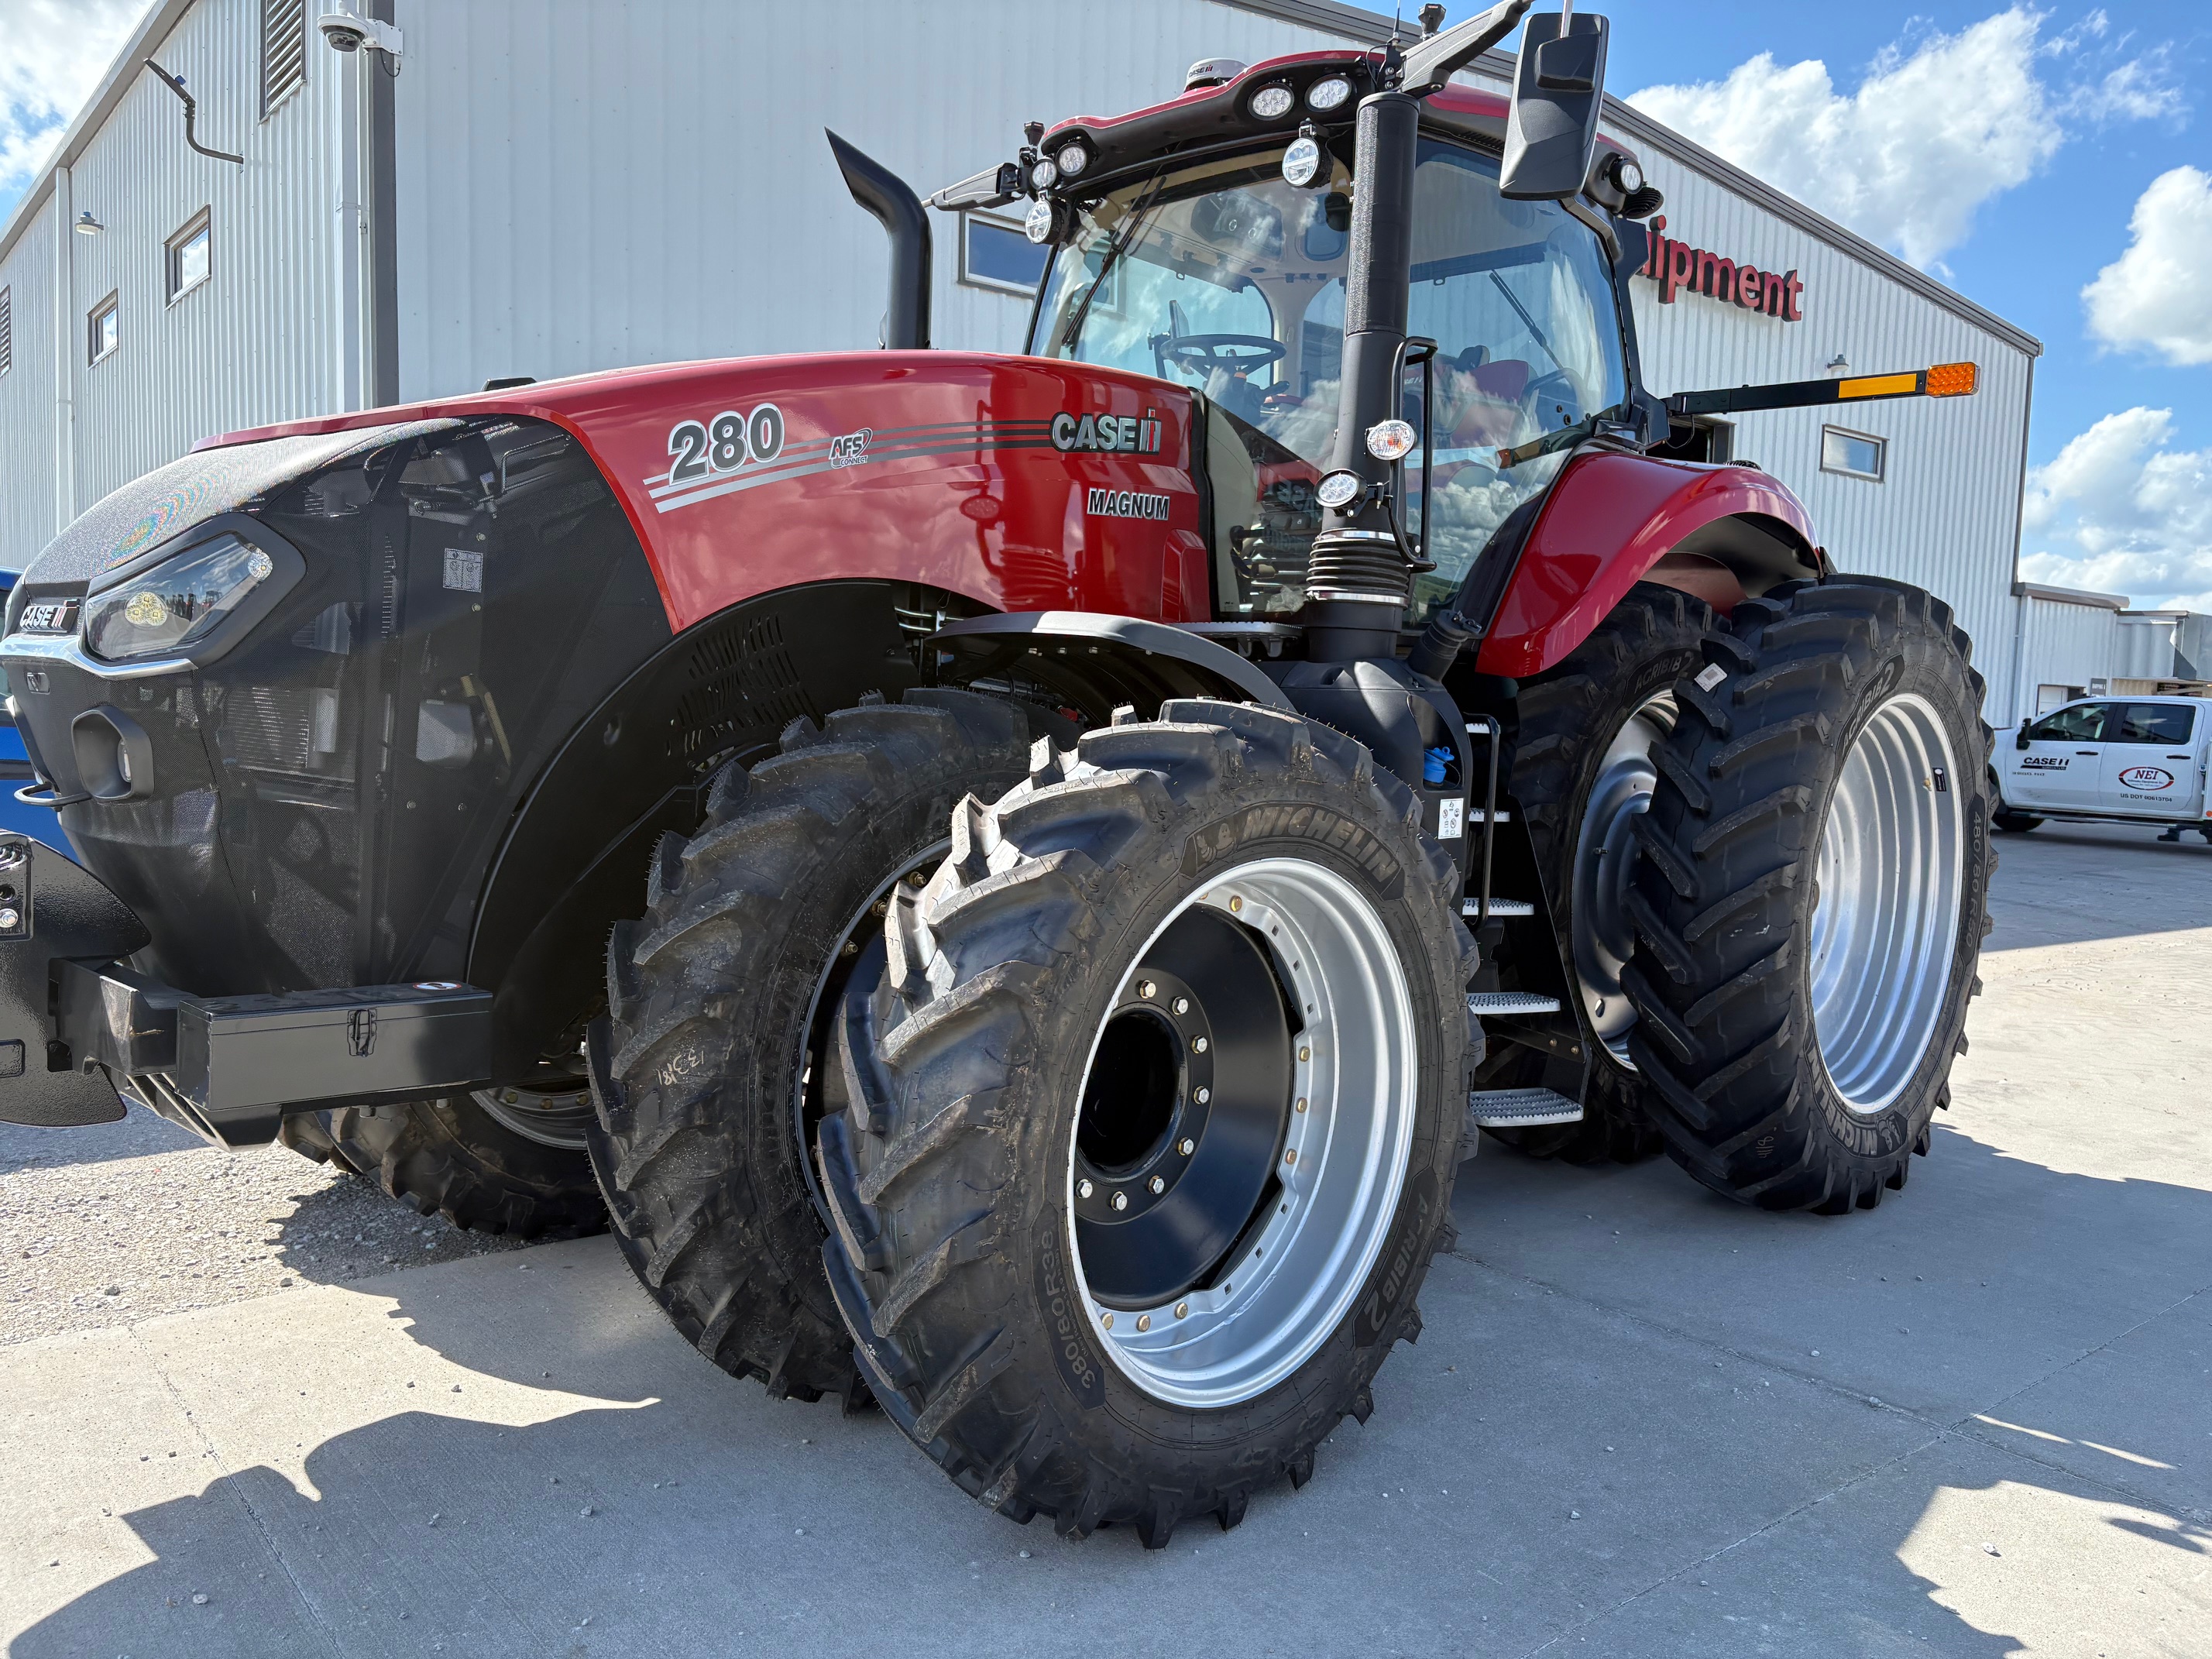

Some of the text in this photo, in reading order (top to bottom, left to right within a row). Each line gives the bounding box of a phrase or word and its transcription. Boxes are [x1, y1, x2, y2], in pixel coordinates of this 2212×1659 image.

[668, 403, 785, 486] 280
[829, 431, 865, 459] AFS
[1052, 413, 1137, 451] CASE
[840, 455, 868, 465] CONNECT
[1087, 487, 1170, 520] MAGNUM
[19, 606, 54, 628] CASE
[1881, 661, 1894, 695] 2
[2024, 757, 2057, 765] CASE
[2135, 769, 2159, 780] NEI
[1239, 806, 1398, 883] MICHELIN
[1972, 811, 1982, 893] 480/80
[1807, 1046, 1878, 1156] MICHELIN
[1363, 1290, 1387, 1332] 2
